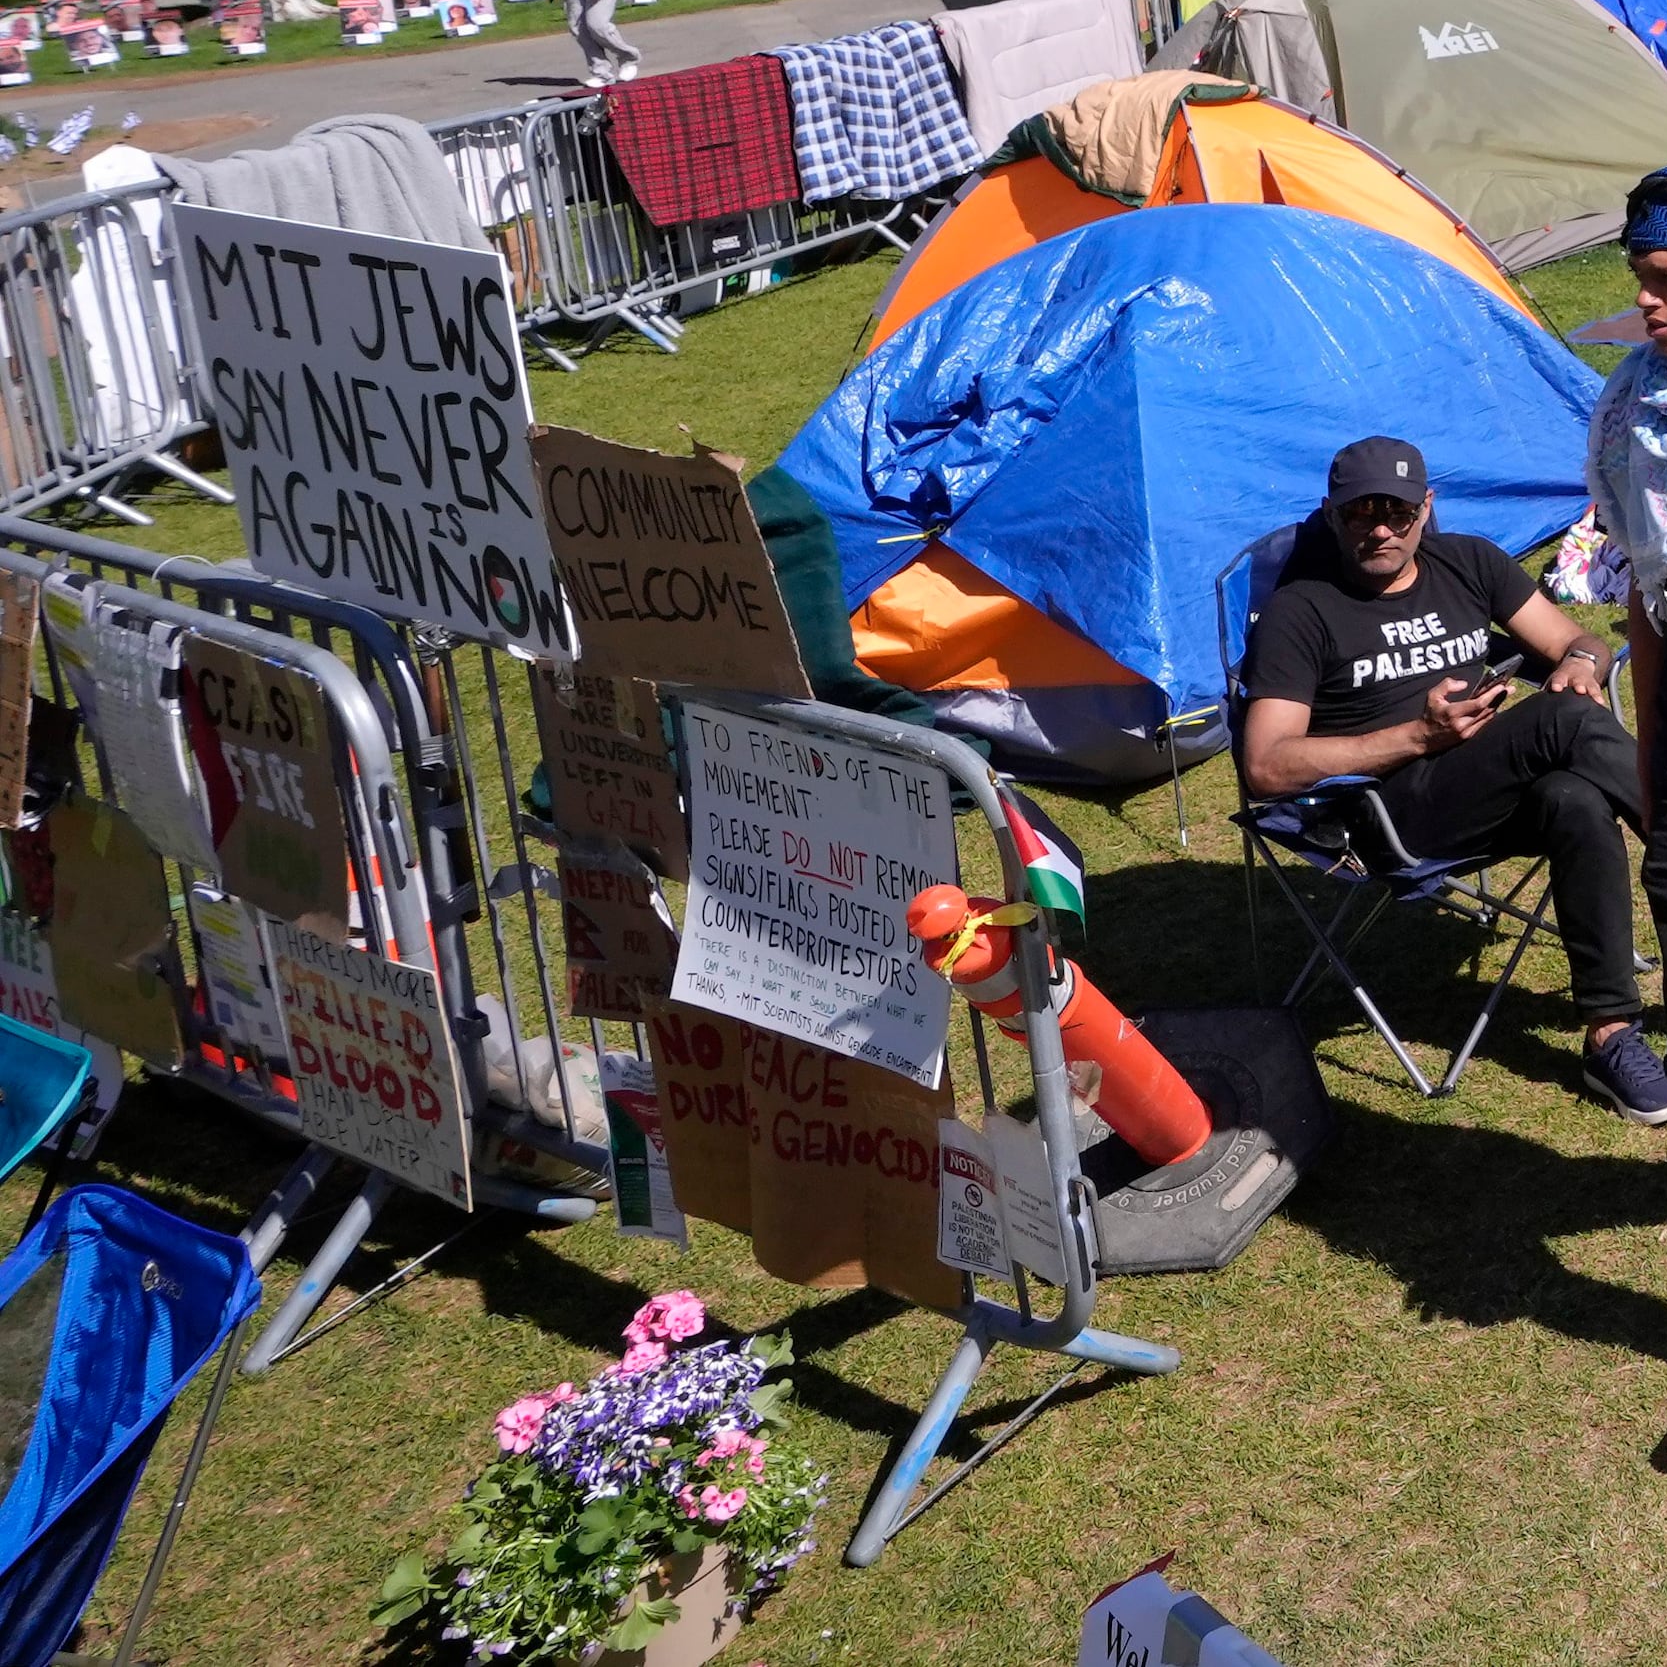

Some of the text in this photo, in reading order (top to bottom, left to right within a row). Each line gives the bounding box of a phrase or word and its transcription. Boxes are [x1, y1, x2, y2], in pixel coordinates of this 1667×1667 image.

[195, 235, 516, 402] MIT JEWS
[212, 357, 533, 519] SAY NEVER
[251, 464, 468, 607] AGAIN IS
[550, 464, 741, 545] COMMUNITY
[428, 541, 571, 652] NOW
[558, 556, 769, 631] WELCOME
[1380, 611, 1447, 647] FREE
[1352, 627, 1489, 688] PALESTINE
[220, 739, 317, 831] FIRE
[562, 758, 654, 799] LEFT IN
[692, 715, 937, 820] TO FRIENDS OF THE
[586, 790, 667, 842] GAZA
[709, 812, 772, 858] PLEASE
[782, 830, 811, 869] DO
[829, 842, 868, 886] NOT
[703, 854, 819, 922] SIGNS/FLAGS
[829, 892, 896, 948] POSTED
[266, 919, 336, 972] THERE
[366, 958, 438, 1011] MORE
[701, 894, 918, 997] COUNTERPROTESTORS
[761, 977, 784, 995] WHAT
[790, 989, 802, 1002] WE
[763, 1000, 813, 1033] SCIENTISTS
[813, 1022, 846, 1045] AGAINST
[767, 961, 828, 993] DISTINCTION
[834, 982, 881, 1010] BETWEEN
[886, 1001, 908, 1020] WHAT
[913, 1013, 928, 1029] WE
[295, 1075, 355, 1119] THAN
[653, 1013, 723, 1071] NO
[739, 1023, 849, 1108] PEACE
[357, 1125, 421, 1177] WATER
[772, 1110, 941, 1189] GENOCID
[1152, 1171, 1229, 1209] Rubber
[948, 1222, 957, 1233] IS
[958, 1224, 974, 1237] NOT
